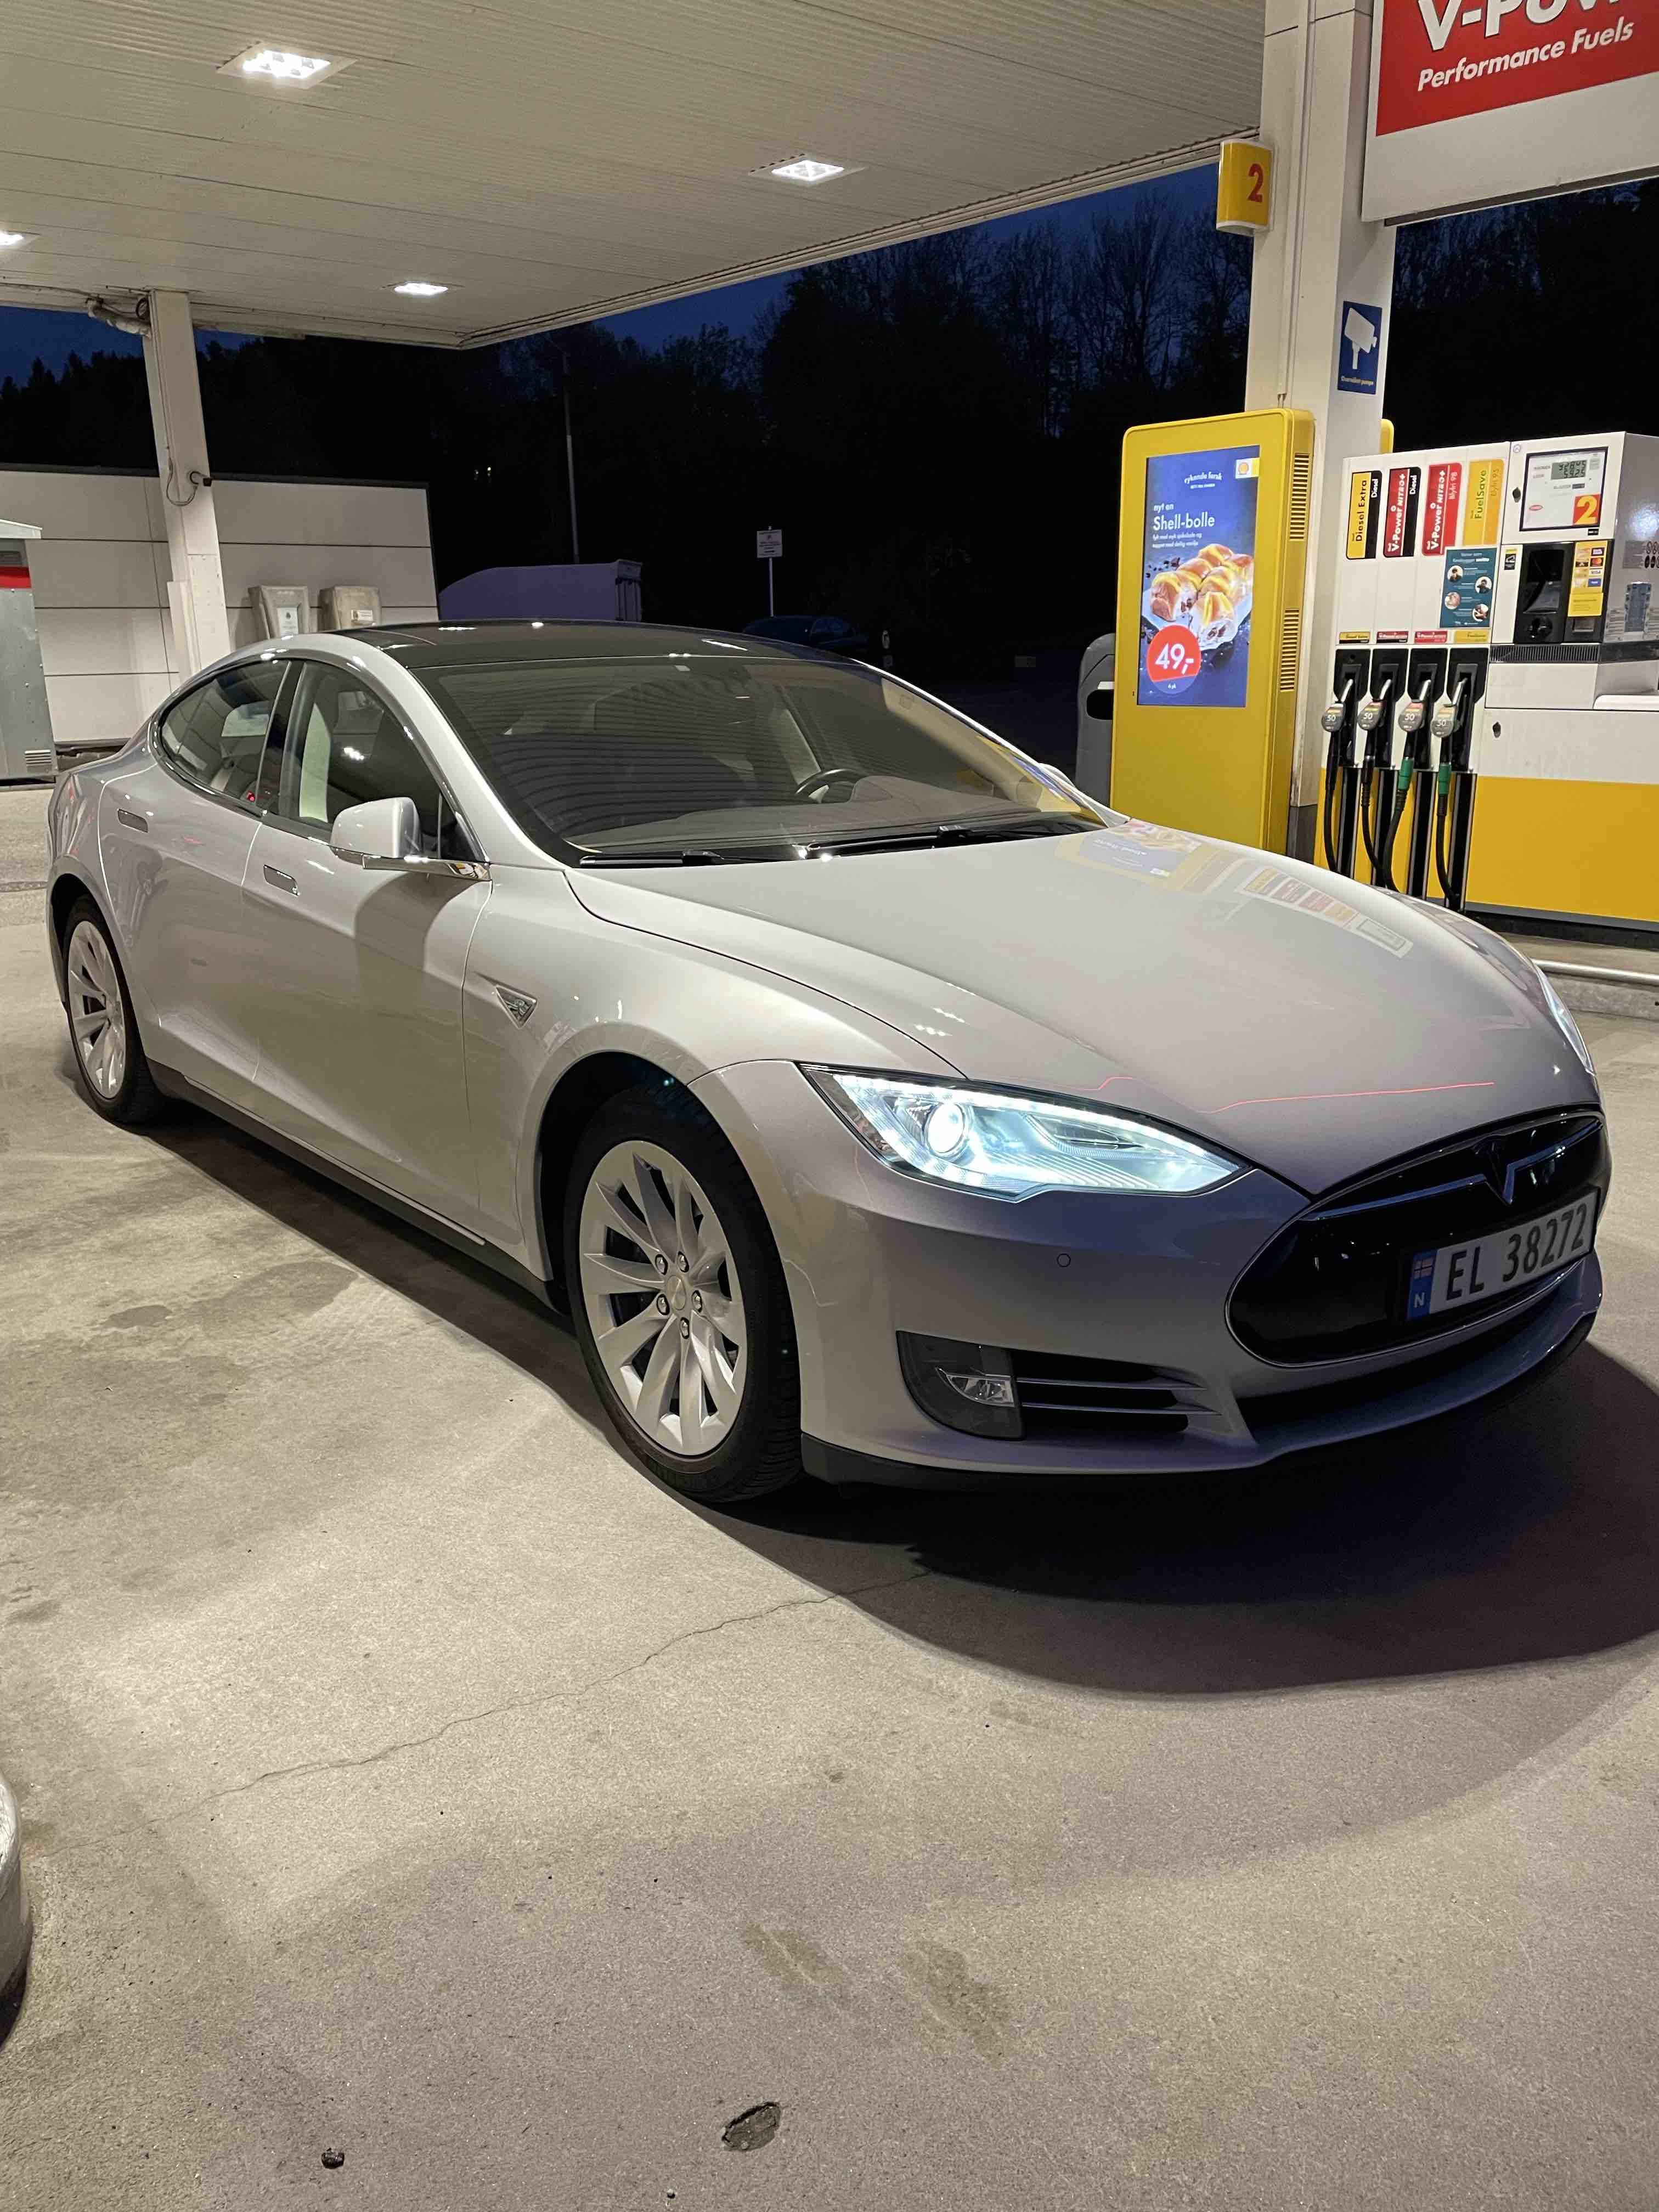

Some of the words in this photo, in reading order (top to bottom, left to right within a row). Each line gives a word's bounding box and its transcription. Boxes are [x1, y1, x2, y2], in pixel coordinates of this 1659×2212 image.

[1418, 39, 1566, 92] Performance
[1571, 16, 1634, 54] Fuels
[1248, 163, 1263, 202] 2
[1358, 479, 1367, 507] Extra
[1475, 470, 1486, 519] FuelSave
[1576, 495, 1598, 525] 2
[1153, 511, 1215, 531] Shell-bolle
[1356, 511, 1364, 541] Diesel
[1391, 507, 1402, 552] V-Power
[1430, 504, 1442, 550] V-Power
[1155, 642, 1194, 675] 49,-
[1447, 1246, 1484, 1300] EL
[1503, 1203, 1587, 1282] 38272
[1414, 1291, 1425, 1308] N
